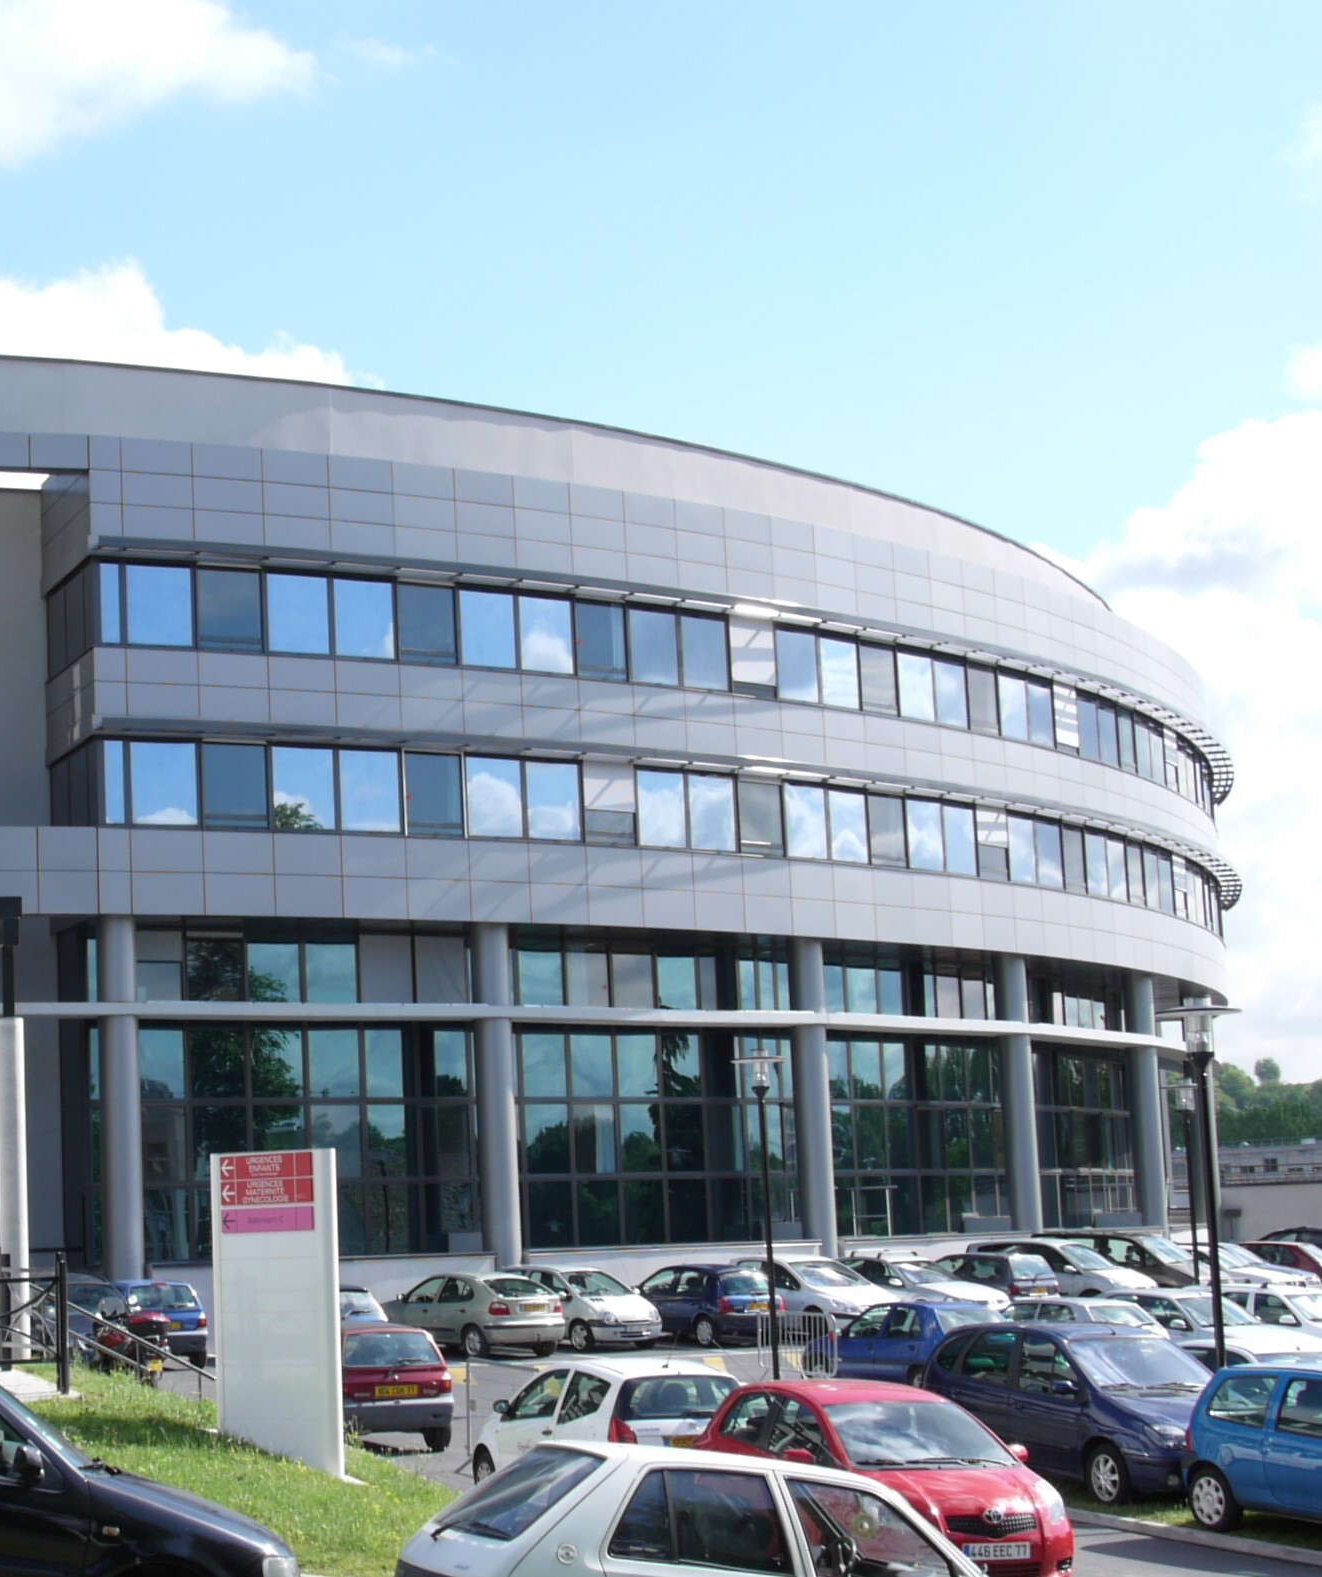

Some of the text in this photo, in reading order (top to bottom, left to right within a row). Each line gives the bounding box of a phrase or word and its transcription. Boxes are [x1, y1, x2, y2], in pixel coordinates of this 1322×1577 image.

[246, 1155, 282, 1165] URGENCES
[249, 1164, 280, 1173] ENFANTS
[246, 1180, 283, 1188] URGENCES
[971, 1544, 1027, 1558] 446 EEC 77
